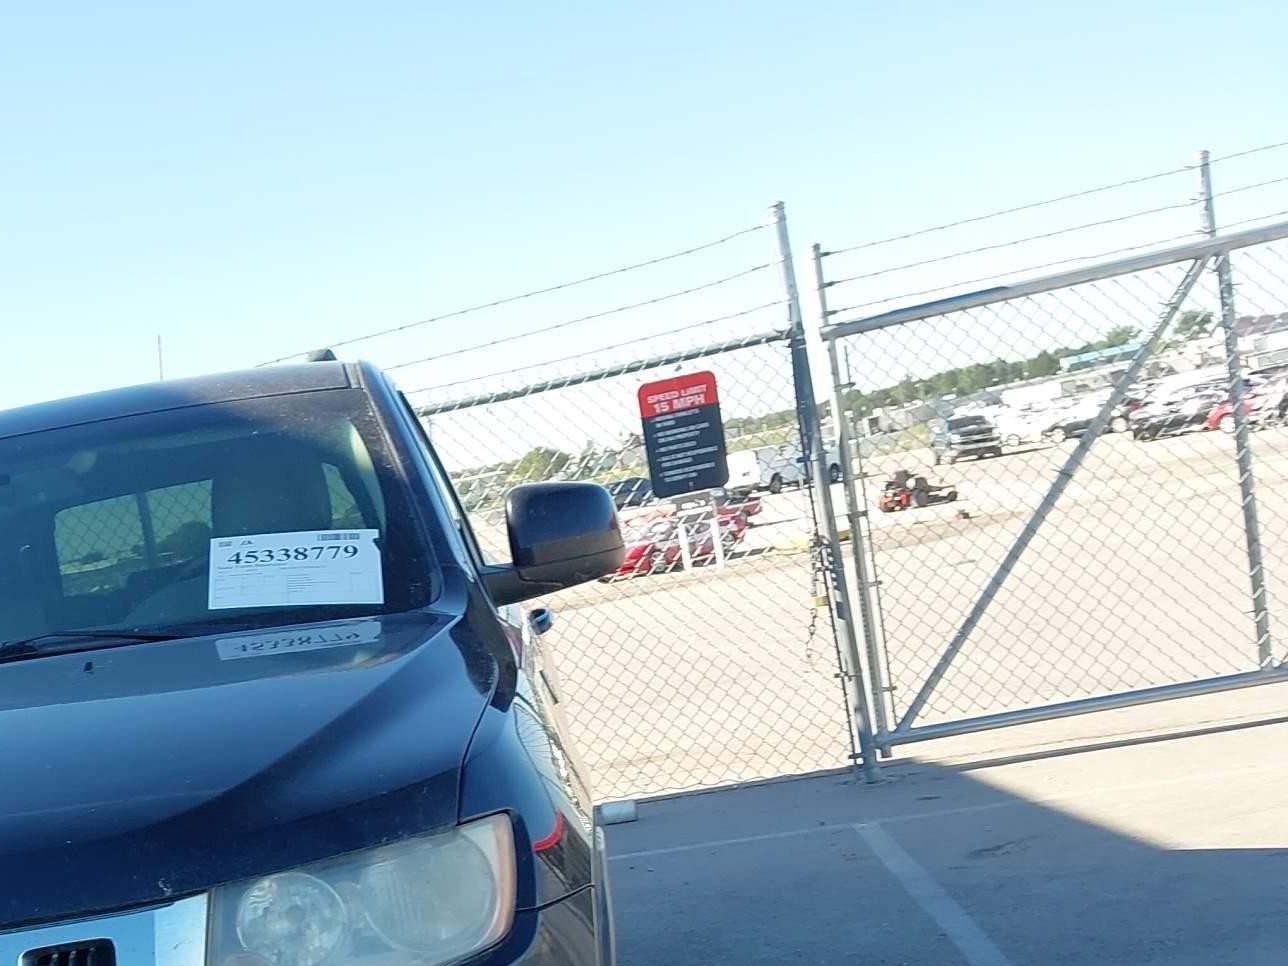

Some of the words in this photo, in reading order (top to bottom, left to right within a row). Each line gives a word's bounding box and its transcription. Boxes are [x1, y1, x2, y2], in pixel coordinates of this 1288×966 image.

[647, 390, 680, 404] SPEED
[680, 384, 706, 397] LIMIT
[653, 401, 670, 414] 15
[673, 393, 704, 410] MPH
[227, 544, 359, 564] 45338779
